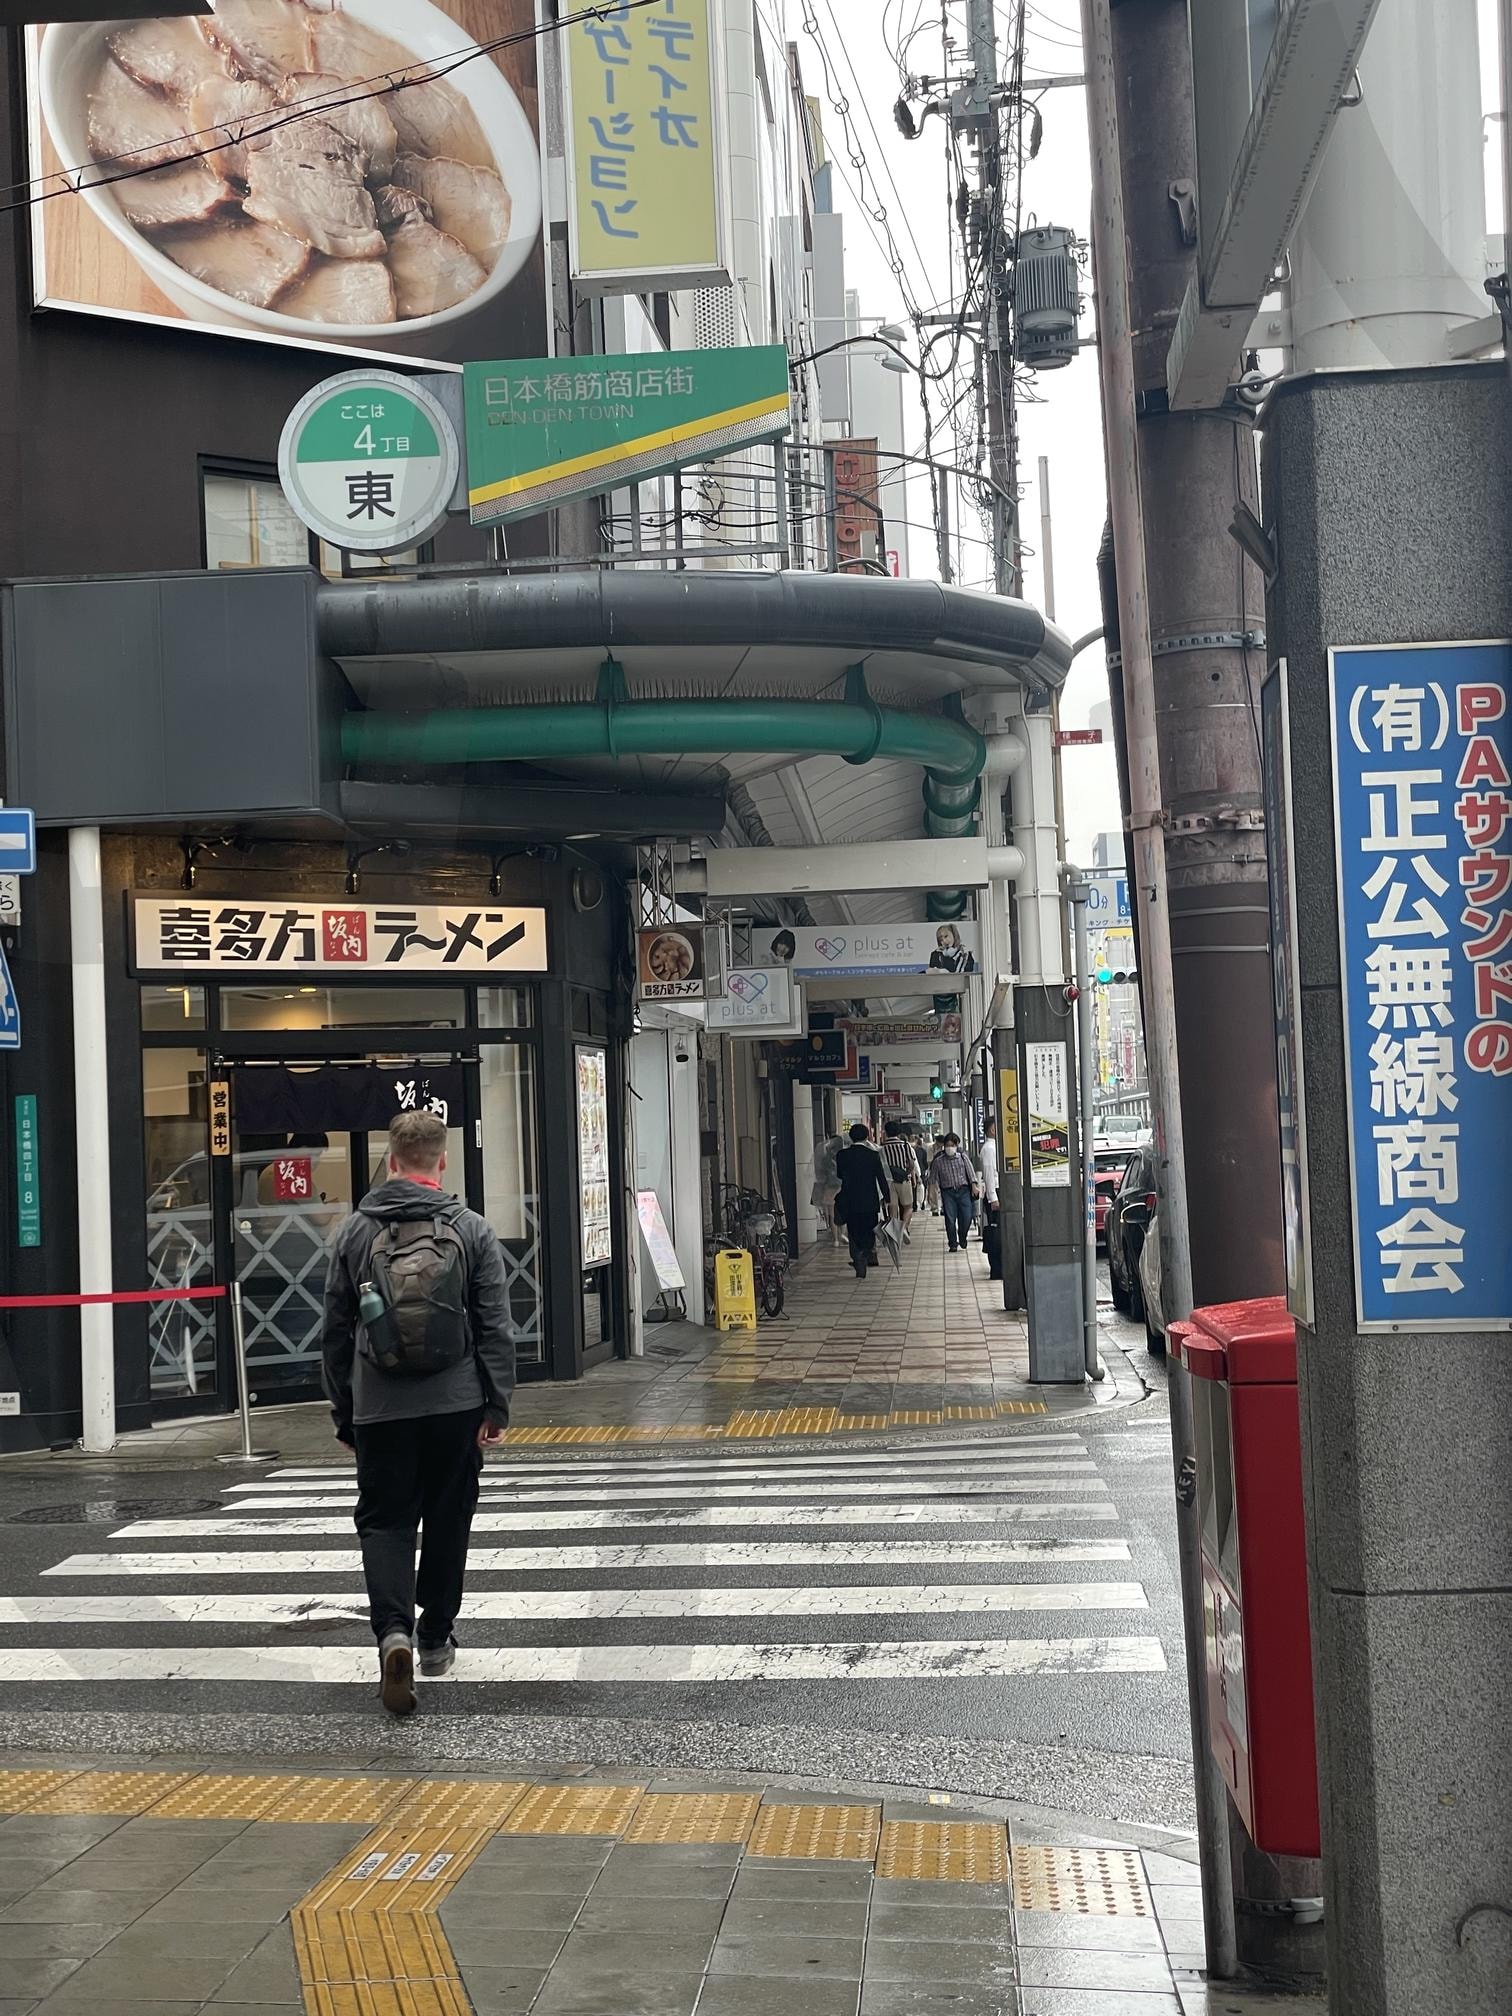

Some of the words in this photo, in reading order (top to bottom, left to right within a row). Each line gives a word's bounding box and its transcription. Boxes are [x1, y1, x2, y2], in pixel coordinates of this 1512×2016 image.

[484, 366, 693, 405] 日本橋筋商店街
[340, 404, 385, 418] ここは
[577, 403, 634, 420] TOWN
[345, 471, 396, 520] 東
[159, 907, 316, 962] 喜多方
[855, 936, 889, 957] plus
[896, 936, 913, 950] at
[722, 1003, 754, 1021] plus
[760, 1000, 777, 1014] at
[213, 1091, 228, 1148] 営業中
[24, 1191, 33, 1204] 8
